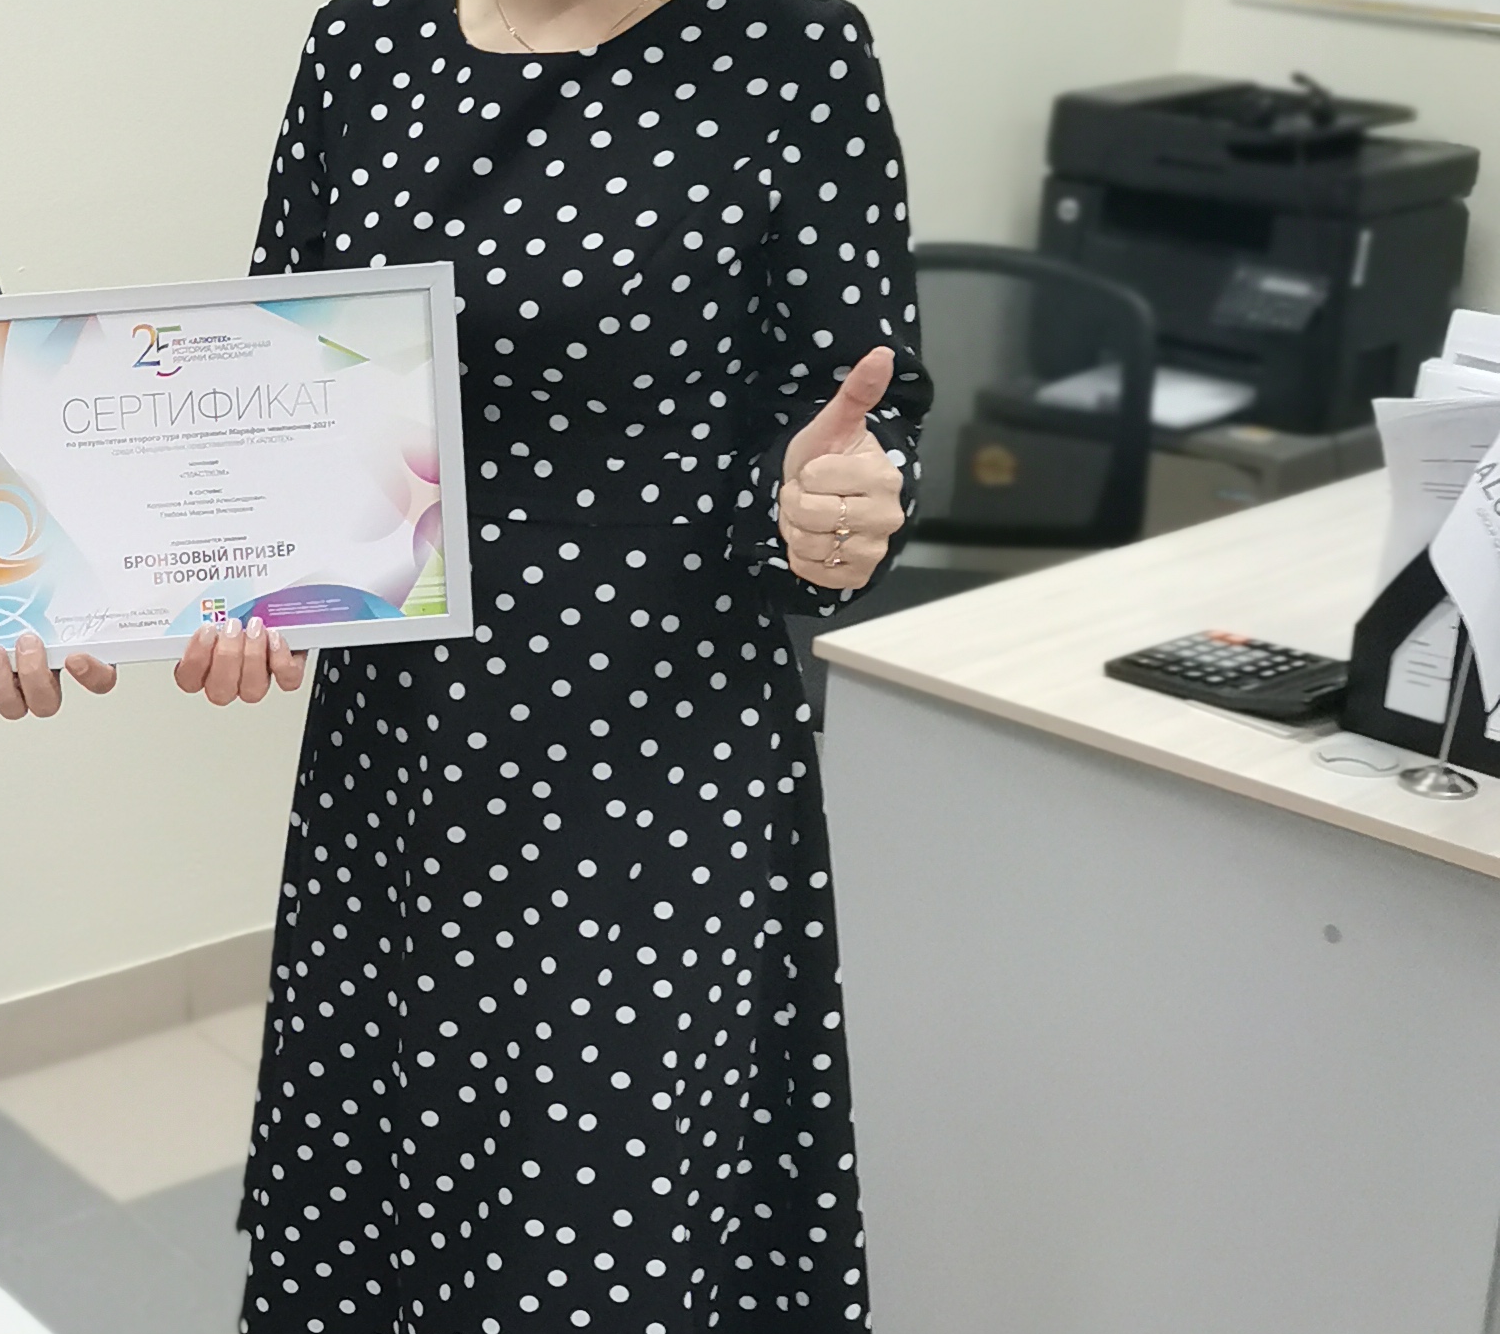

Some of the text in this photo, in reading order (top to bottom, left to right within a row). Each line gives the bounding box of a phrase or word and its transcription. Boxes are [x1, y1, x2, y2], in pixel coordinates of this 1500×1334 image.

[131, 323, 183, 377] 25
[62, 378, 336, 435] СЕРТИФИКАТ
[123, 546, 229, 570] БРОНЗОВЫЙ
[232, 540, 296, 560] ПРИЗЁР
[153, 563, 269, 586] ВТОРОЙ ЛИГИ
